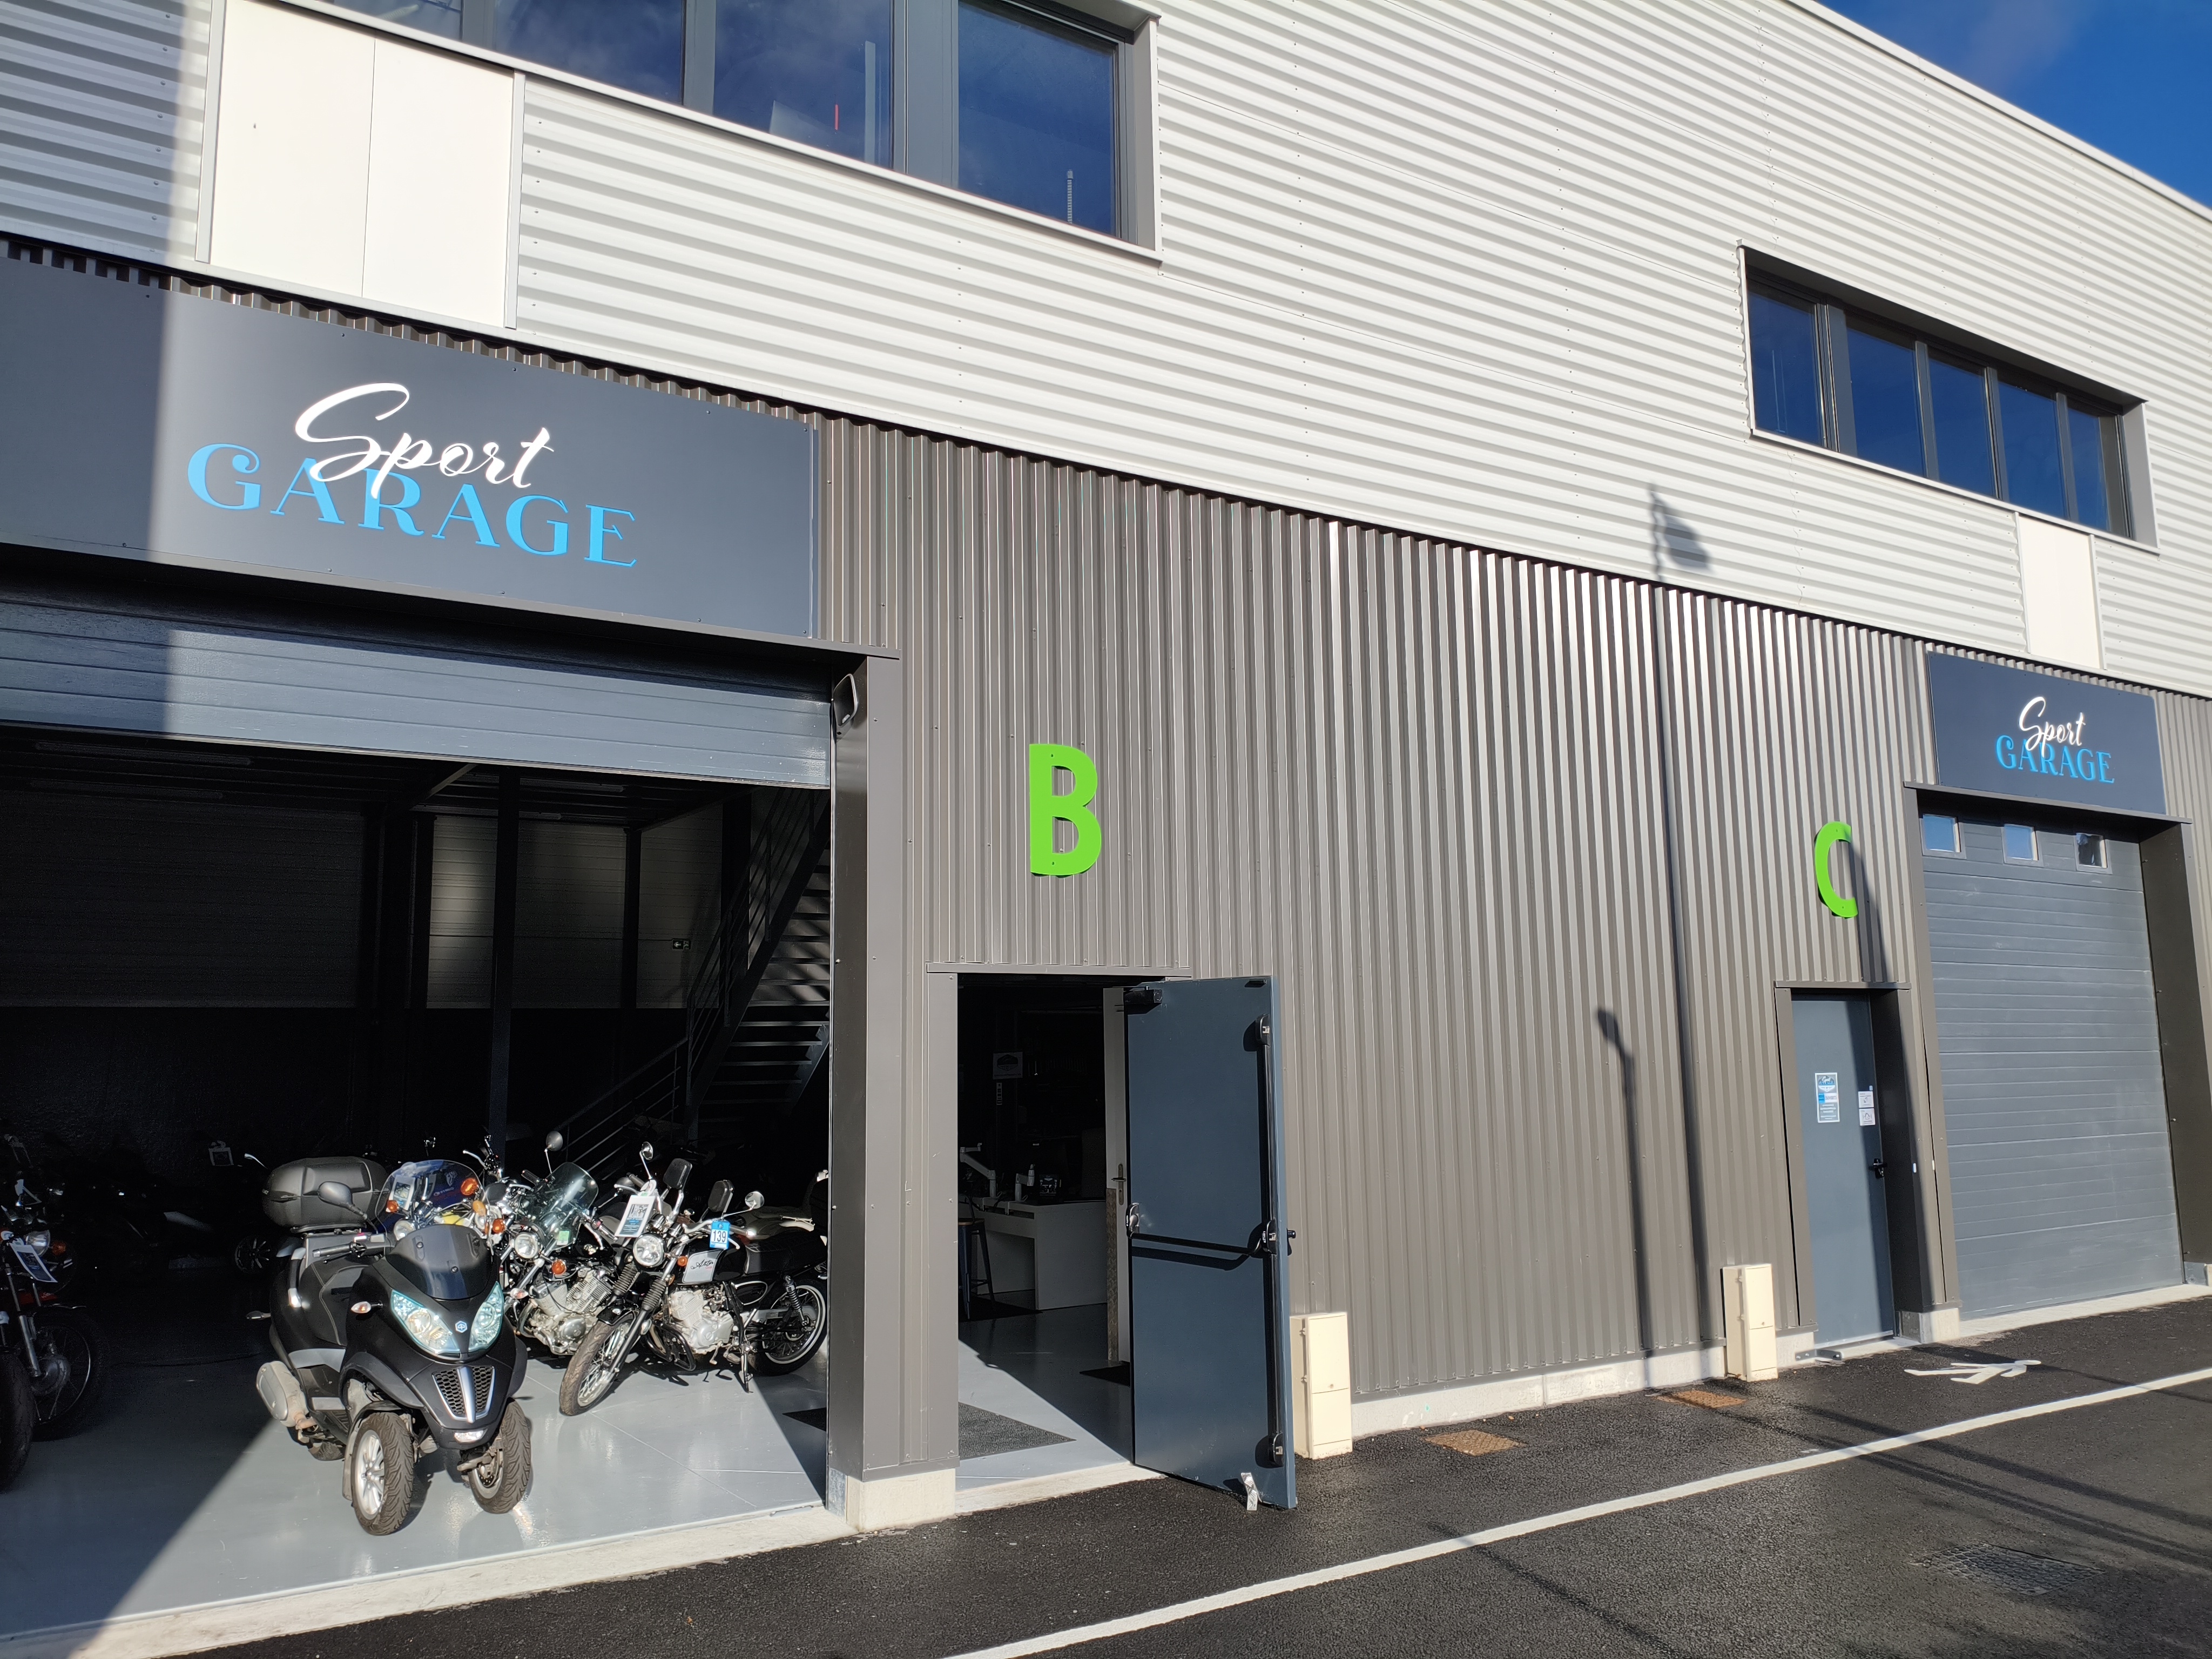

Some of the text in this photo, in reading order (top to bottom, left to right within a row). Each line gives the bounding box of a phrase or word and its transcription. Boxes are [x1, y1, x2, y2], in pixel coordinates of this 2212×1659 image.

[295, 382, 554, 499] Sport
[187, 443, 637, 567] GARAGE
[1995, 734, 2115, 784] GARAGE
[2019, 696, 2086, 758] Sport
[1029, 744, 1102, 876] B
[1815, 821, 1858, 918] C
[713, 1230, 726, 1243] 139
